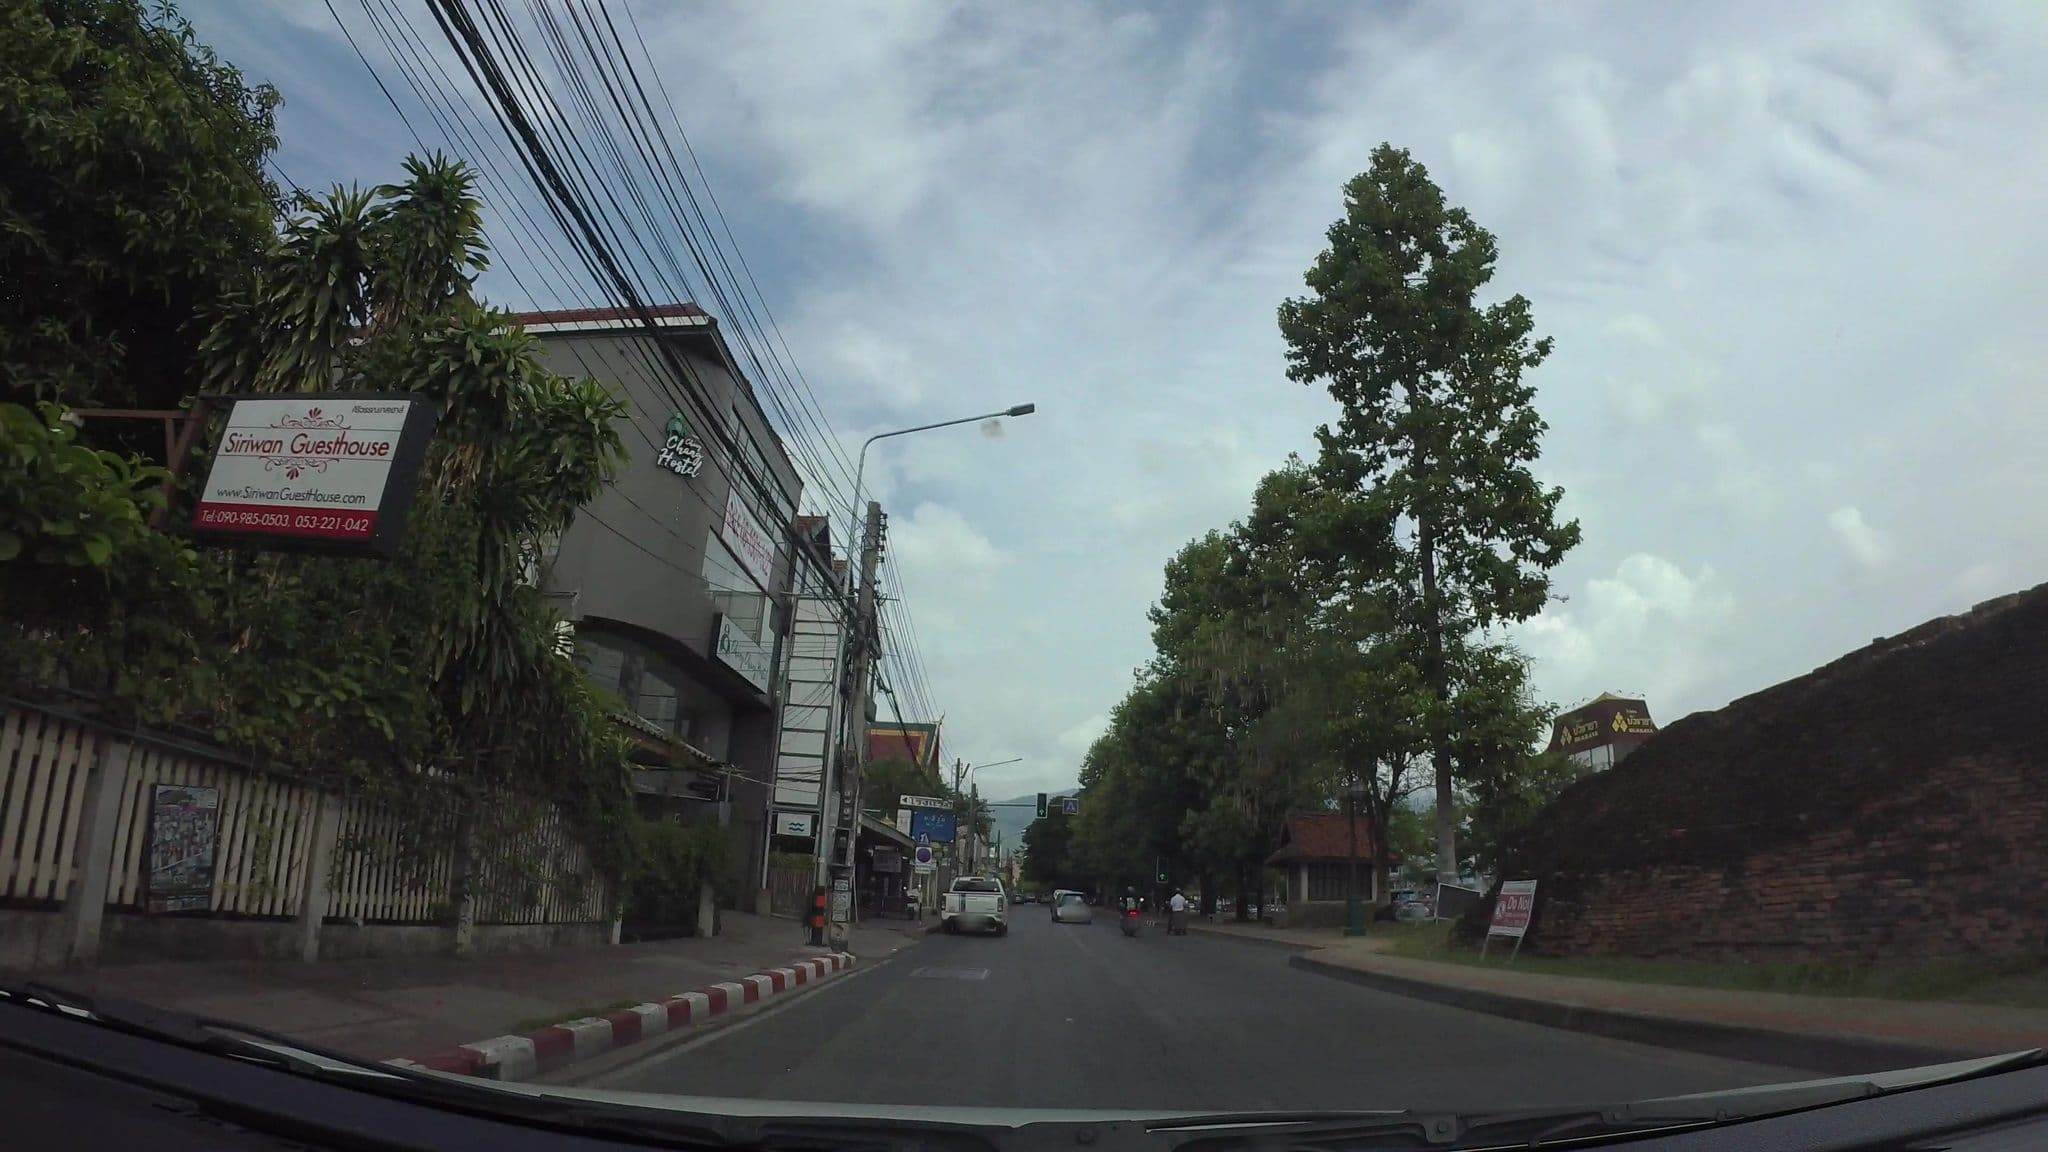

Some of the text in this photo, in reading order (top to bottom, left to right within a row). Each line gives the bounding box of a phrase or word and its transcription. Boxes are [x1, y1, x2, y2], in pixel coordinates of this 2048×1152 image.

[225, 430, 390, 457] Siriwan Guesthouse
[657, 448, 703, 478] Hostel
[216, 486, 366, 504] www.SiriwanGuestHouse.com
[295, 515, 369, 532] 053-221-042
